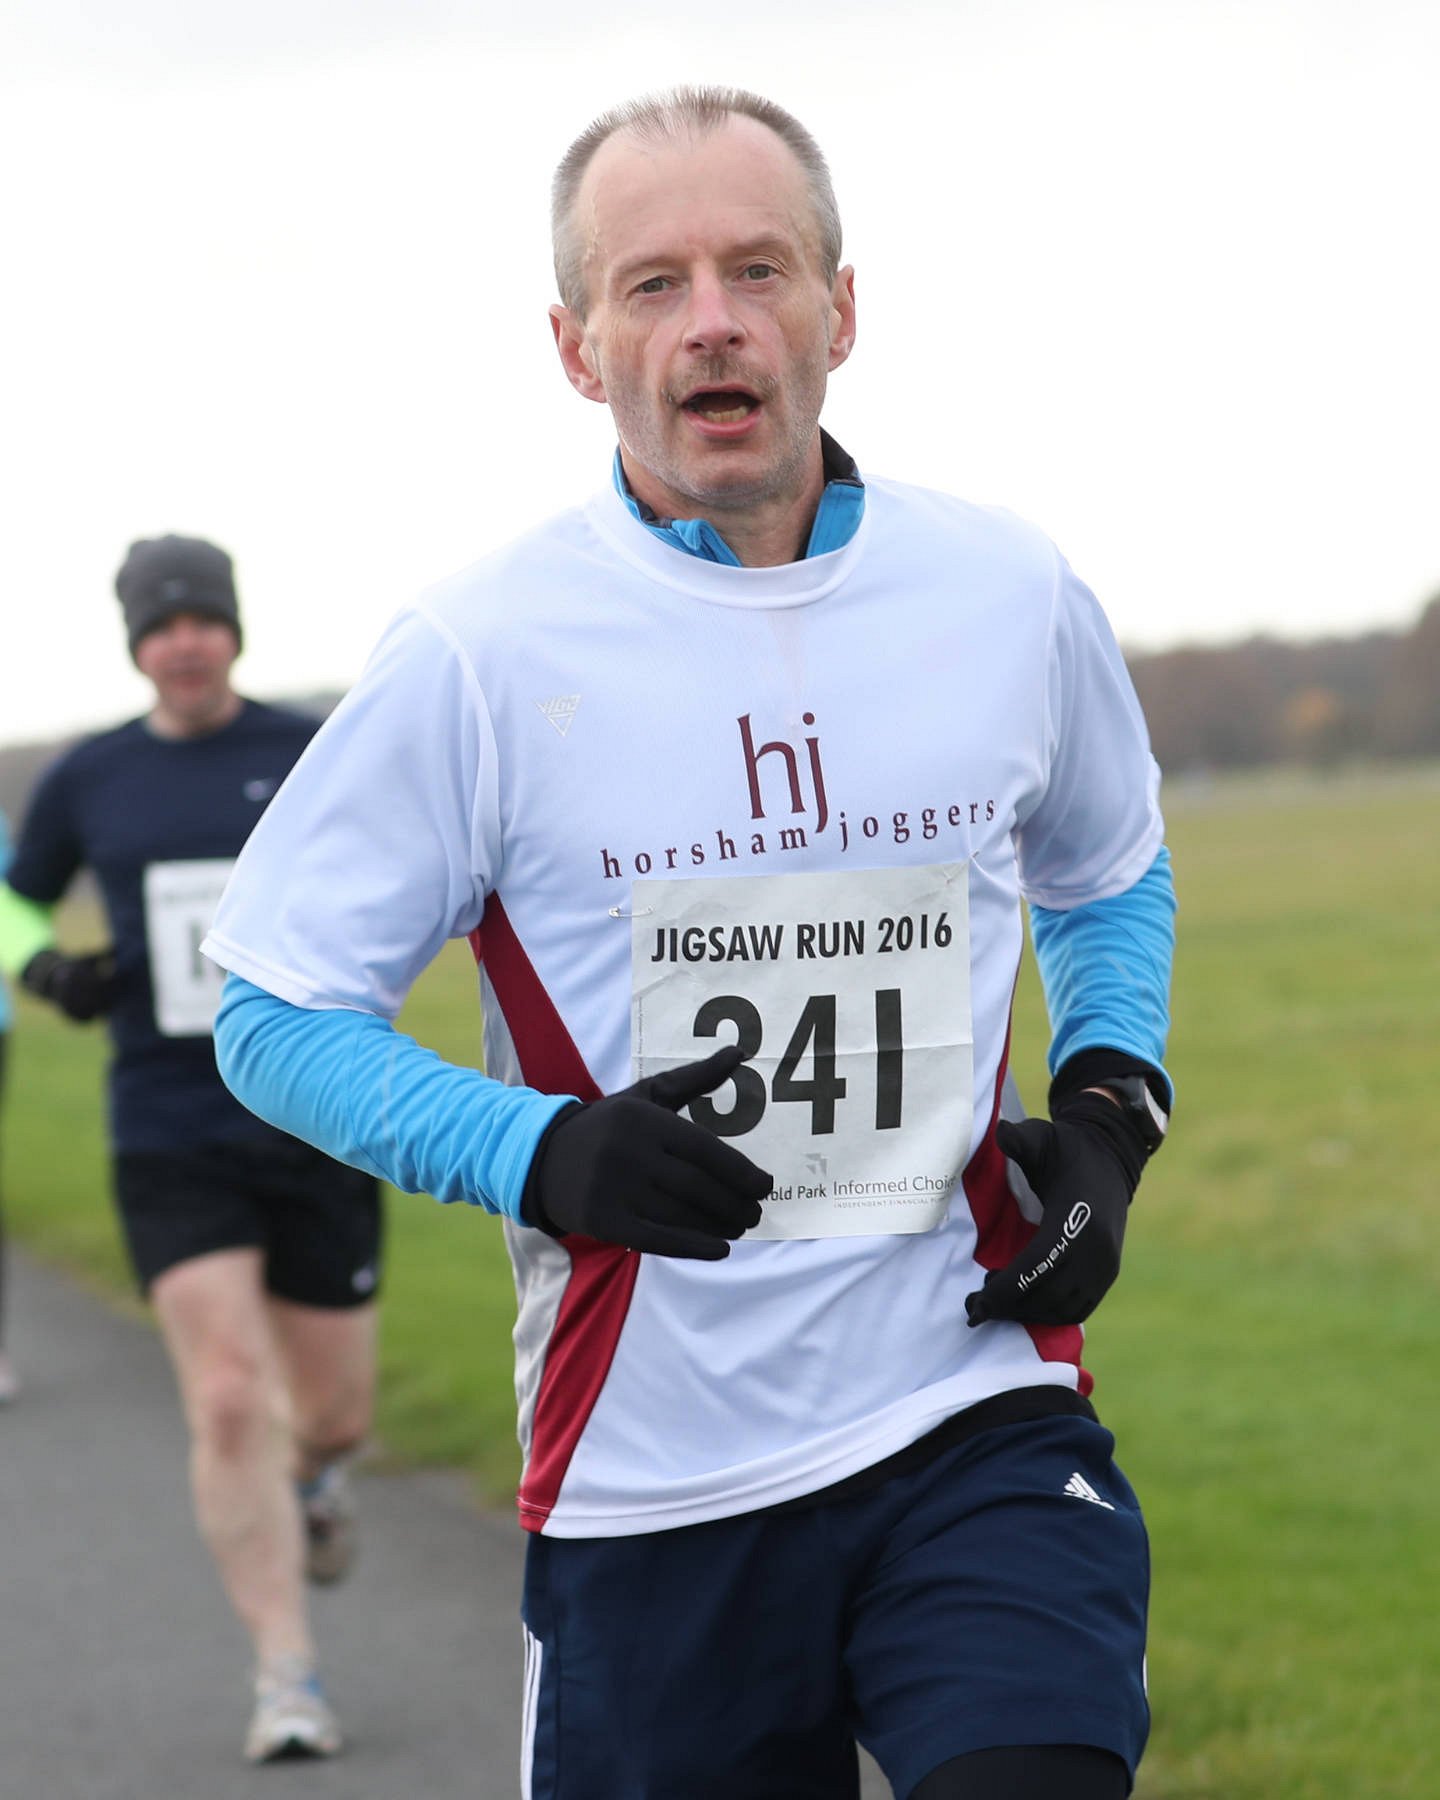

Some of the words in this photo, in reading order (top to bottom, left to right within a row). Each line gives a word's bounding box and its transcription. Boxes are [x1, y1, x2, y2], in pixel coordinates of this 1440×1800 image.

[737, 712, 829, 833] hj
[600, 828, 808, 878] horsham
[840, 800, 994, 852] joggers
[651, 925, 784, 962] JIGSAW
[797, 920, 865, 959] RUN
[877, 912, 952, 953] 2016
[688, 988, 904, 1137] 341
[765, 1185, 792, 1201] old
[798, 1184, 827, 1199] Park
[833, 1177, 907, 1196] Informed
[1018, 1236, 1069, 1292] Kalenji
